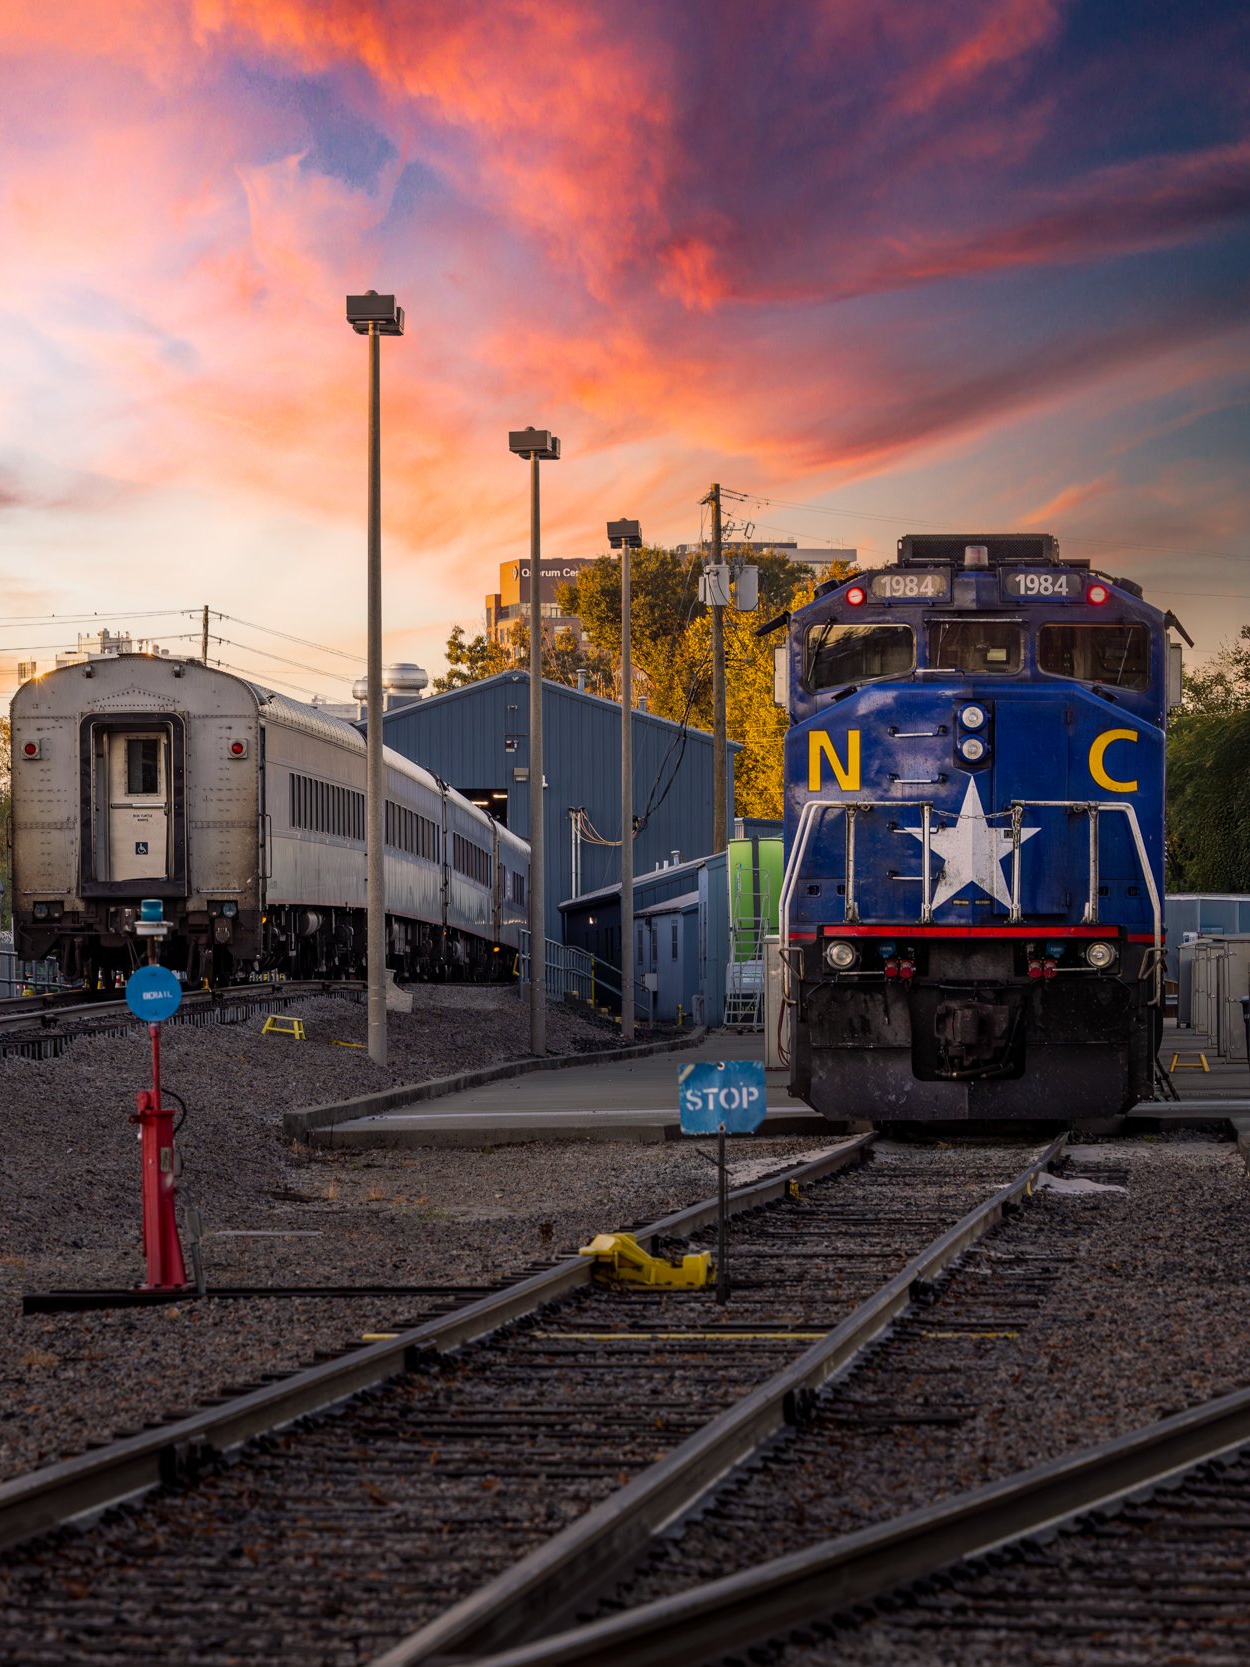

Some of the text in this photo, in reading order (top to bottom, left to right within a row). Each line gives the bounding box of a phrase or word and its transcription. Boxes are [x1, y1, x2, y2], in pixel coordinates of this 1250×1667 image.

[521, 568, 561, 577] Qrum
[880, 575, 935, 597] 1984
[1014, 574, 1069, 596] 1984
[807, 728, 1139, 793] N C
[685, 1087, 759, 1111] STOP
